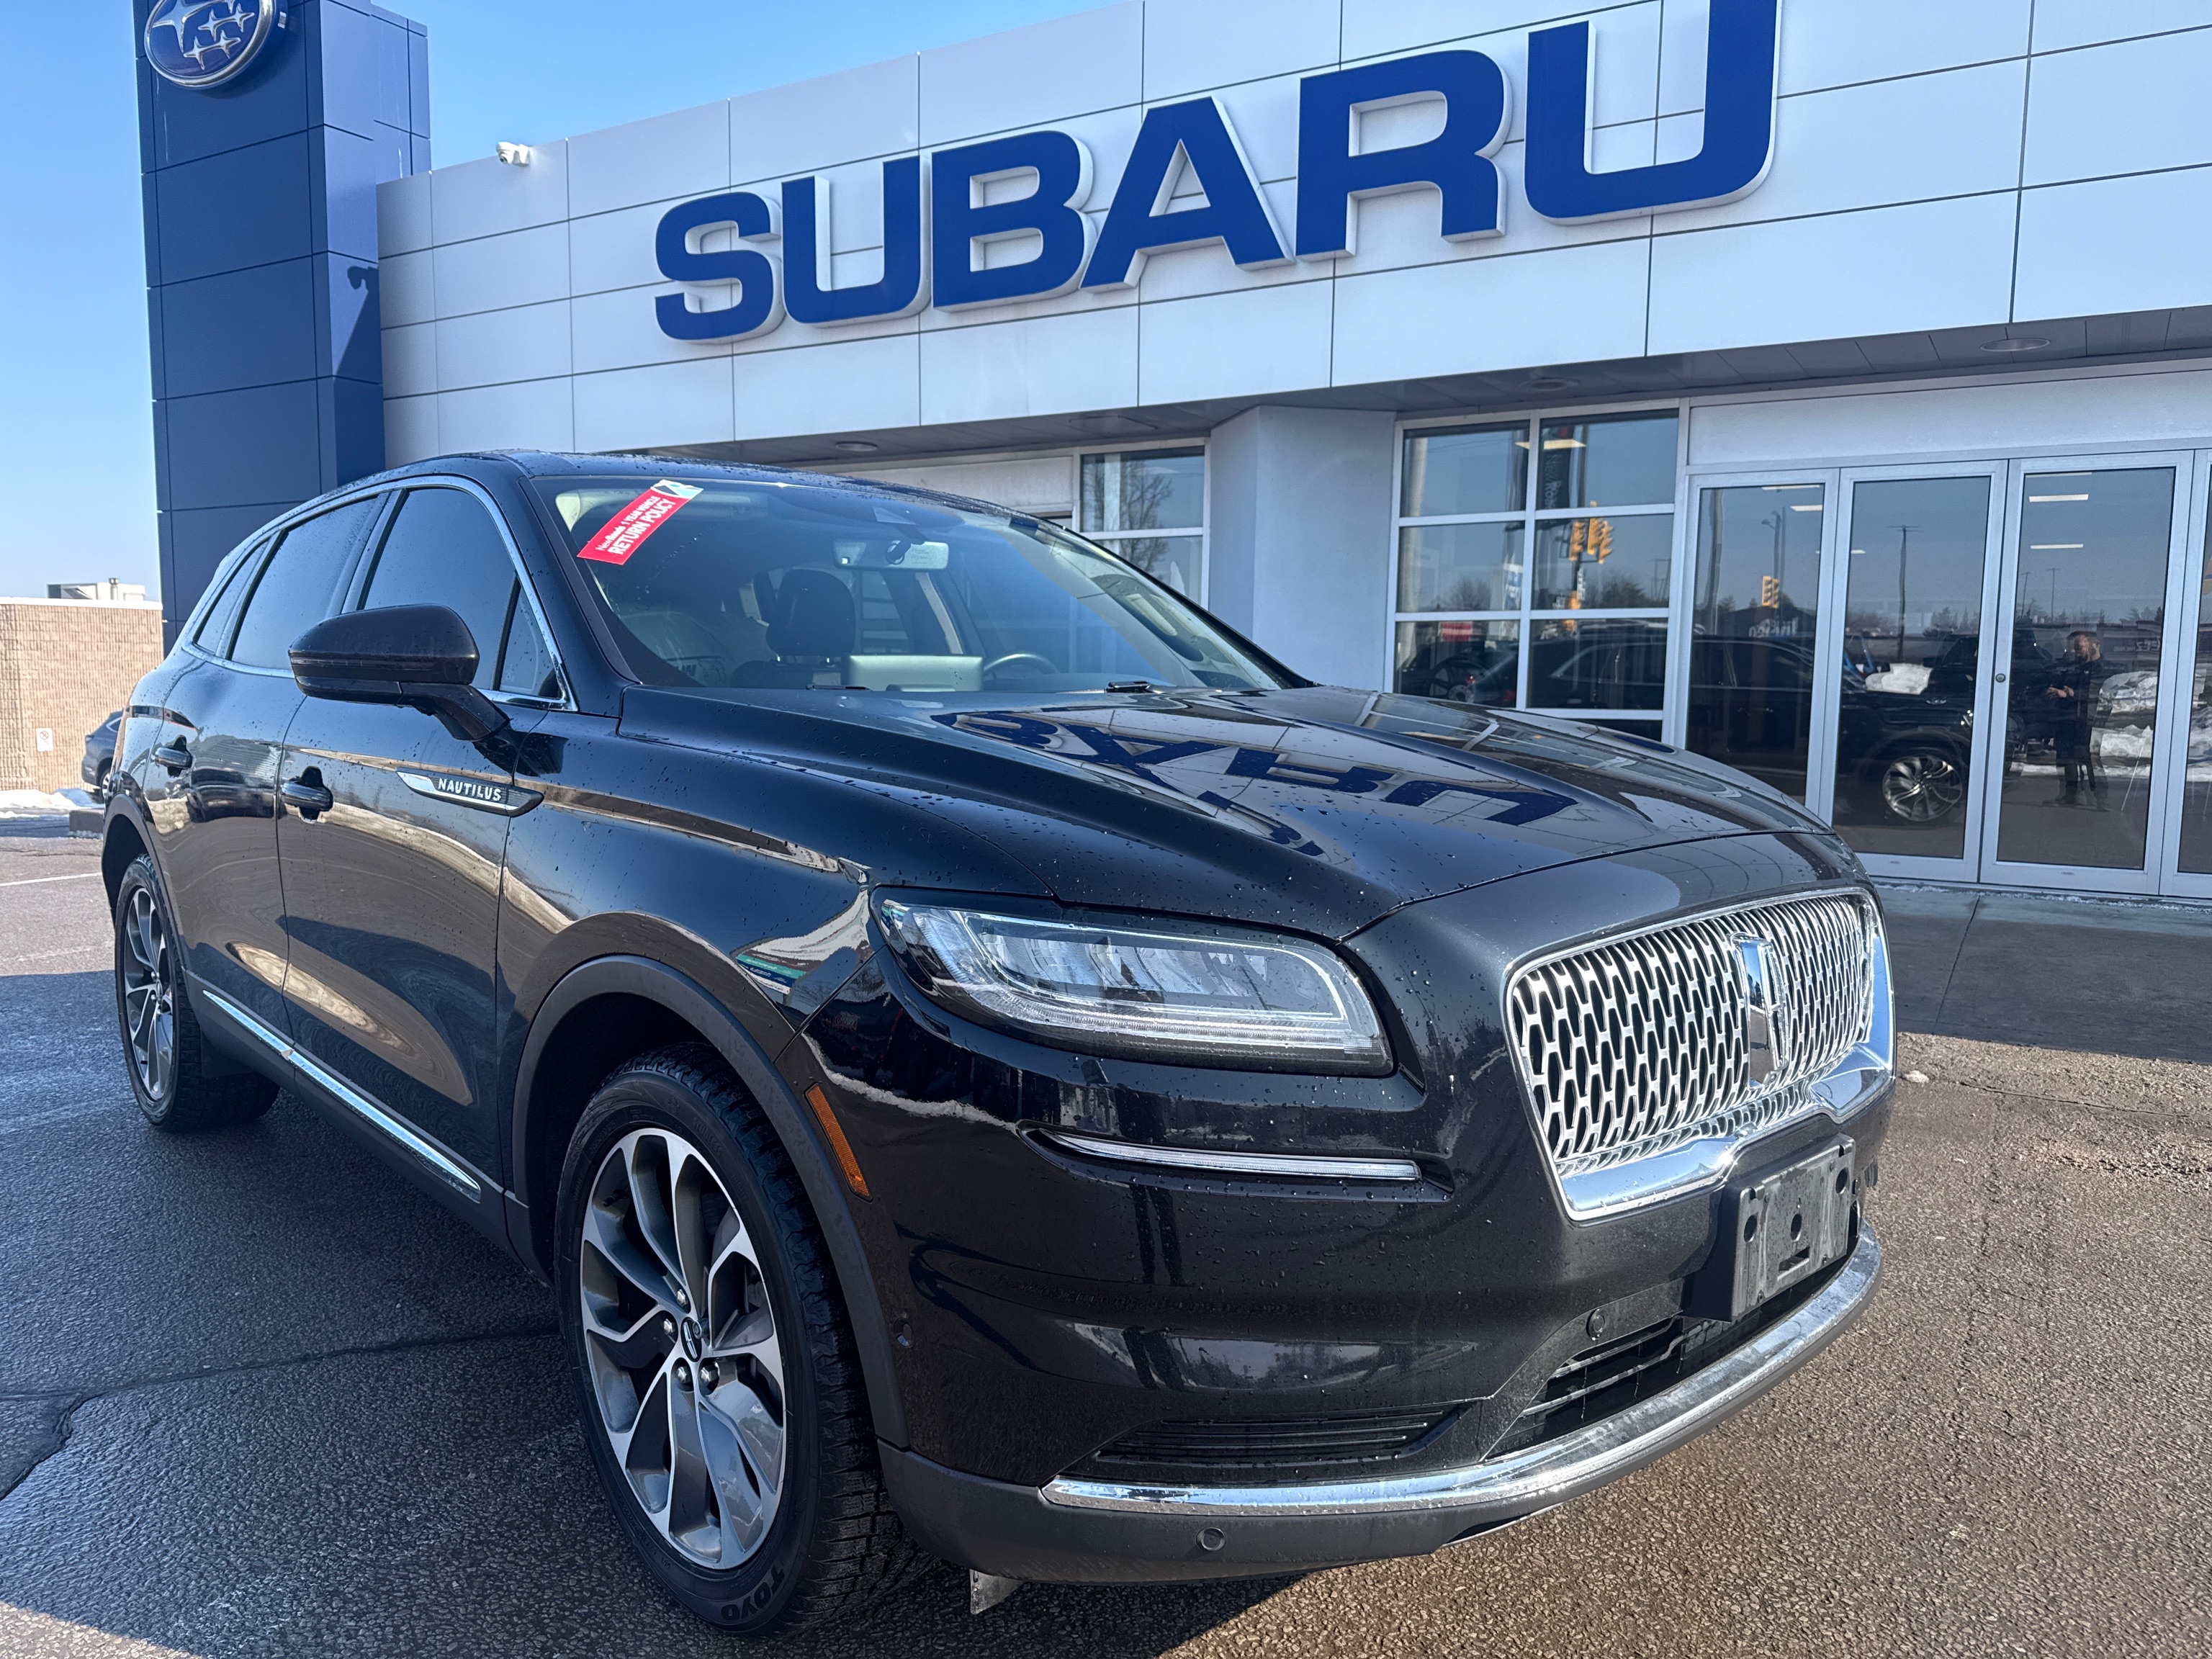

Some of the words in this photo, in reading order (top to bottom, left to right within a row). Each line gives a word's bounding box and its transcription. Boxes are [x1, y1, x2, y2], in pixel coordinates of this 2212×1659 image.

[654, 0, 1779, 343] SUBARU
[607, 521, 651, 554] RETURN
[639, 498, 676, 523] POLICY
[438, 778, 502, 801] NAUTILUS
[721, 1565, 786, 1621] TOYO
